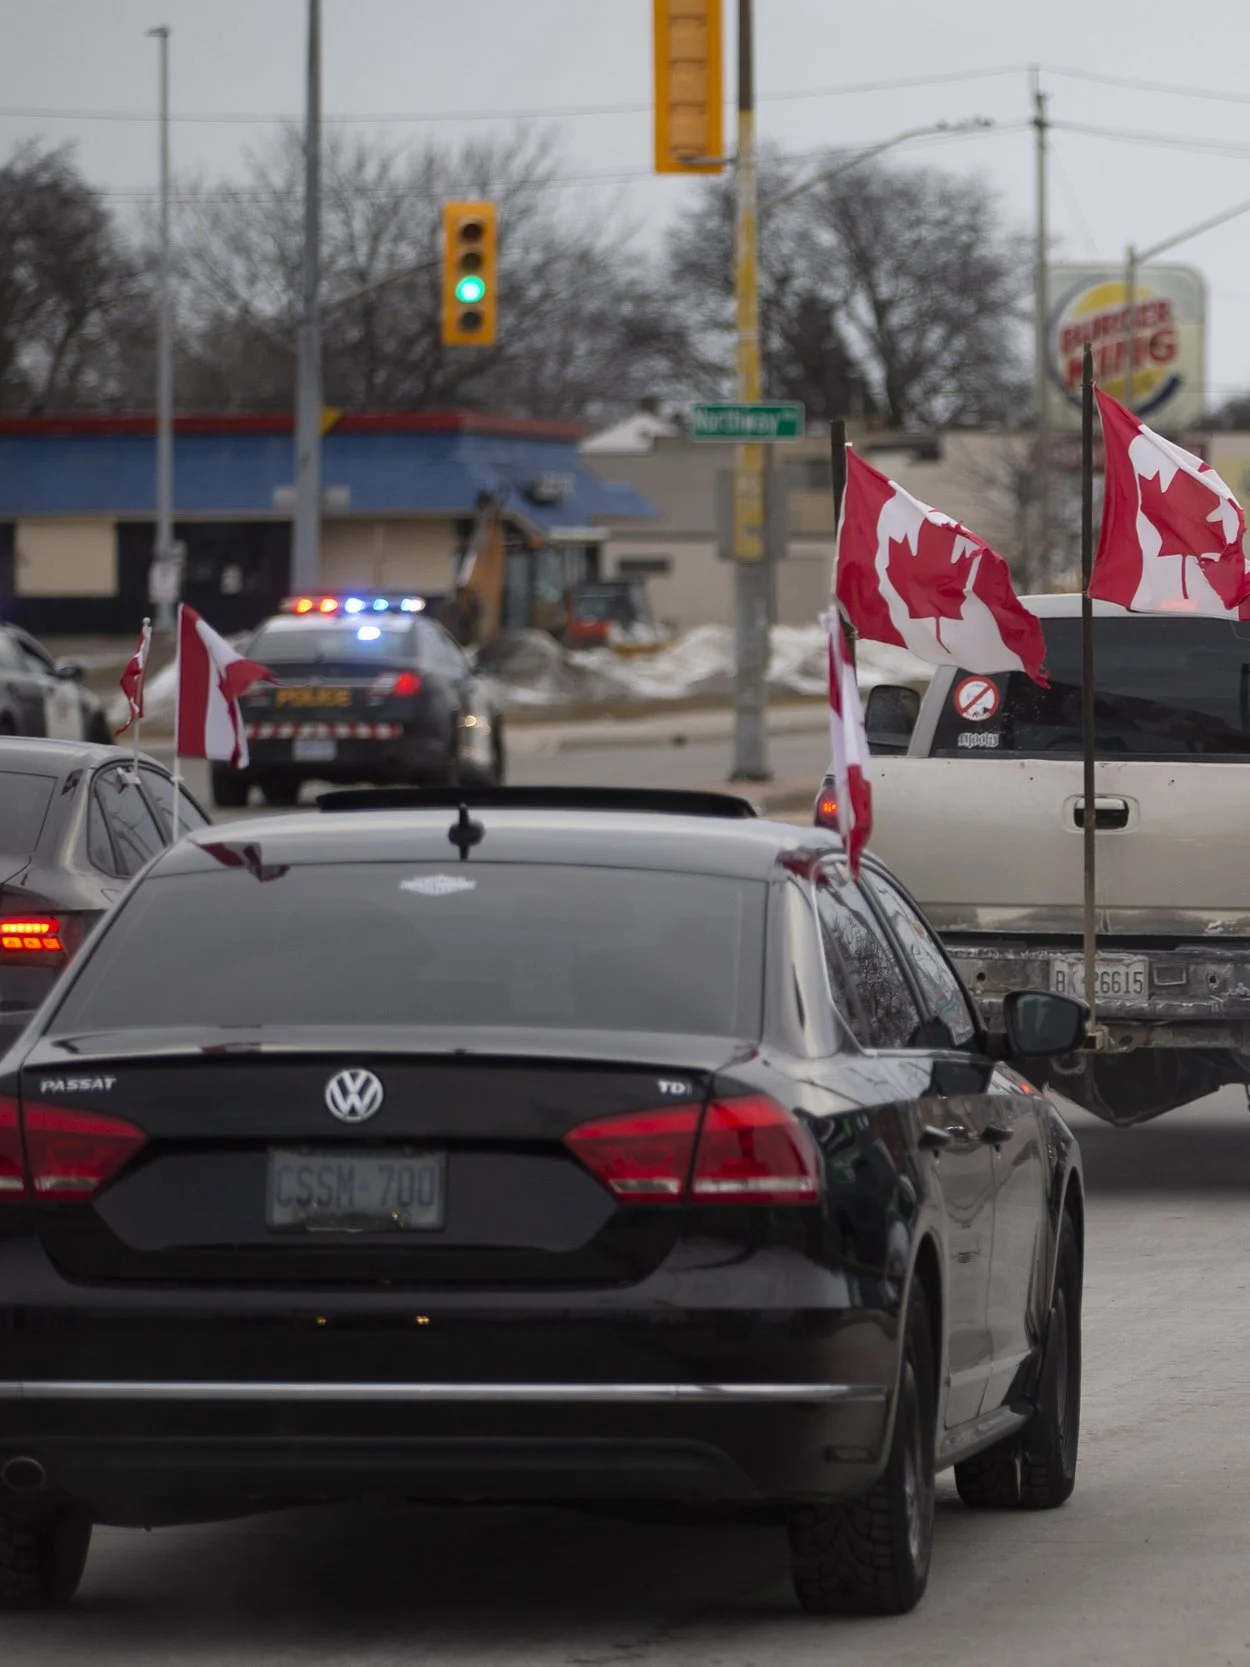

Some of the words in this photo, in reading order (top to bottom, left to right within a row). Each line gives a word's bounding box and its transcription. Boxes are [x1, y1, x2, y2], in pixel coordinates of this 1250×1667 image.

[1061, 301, 1171, 351] BURGER
[1067, 328, 1177, 387] KING
[696, 408, 779, 436] Northway
[276, 687, 351, 708] POLICE
[41, 1077, 117, 1094] PASSAT
[276, 1165, 355, 1208] CSSM
[378, 1165, 435, 1208] 700
